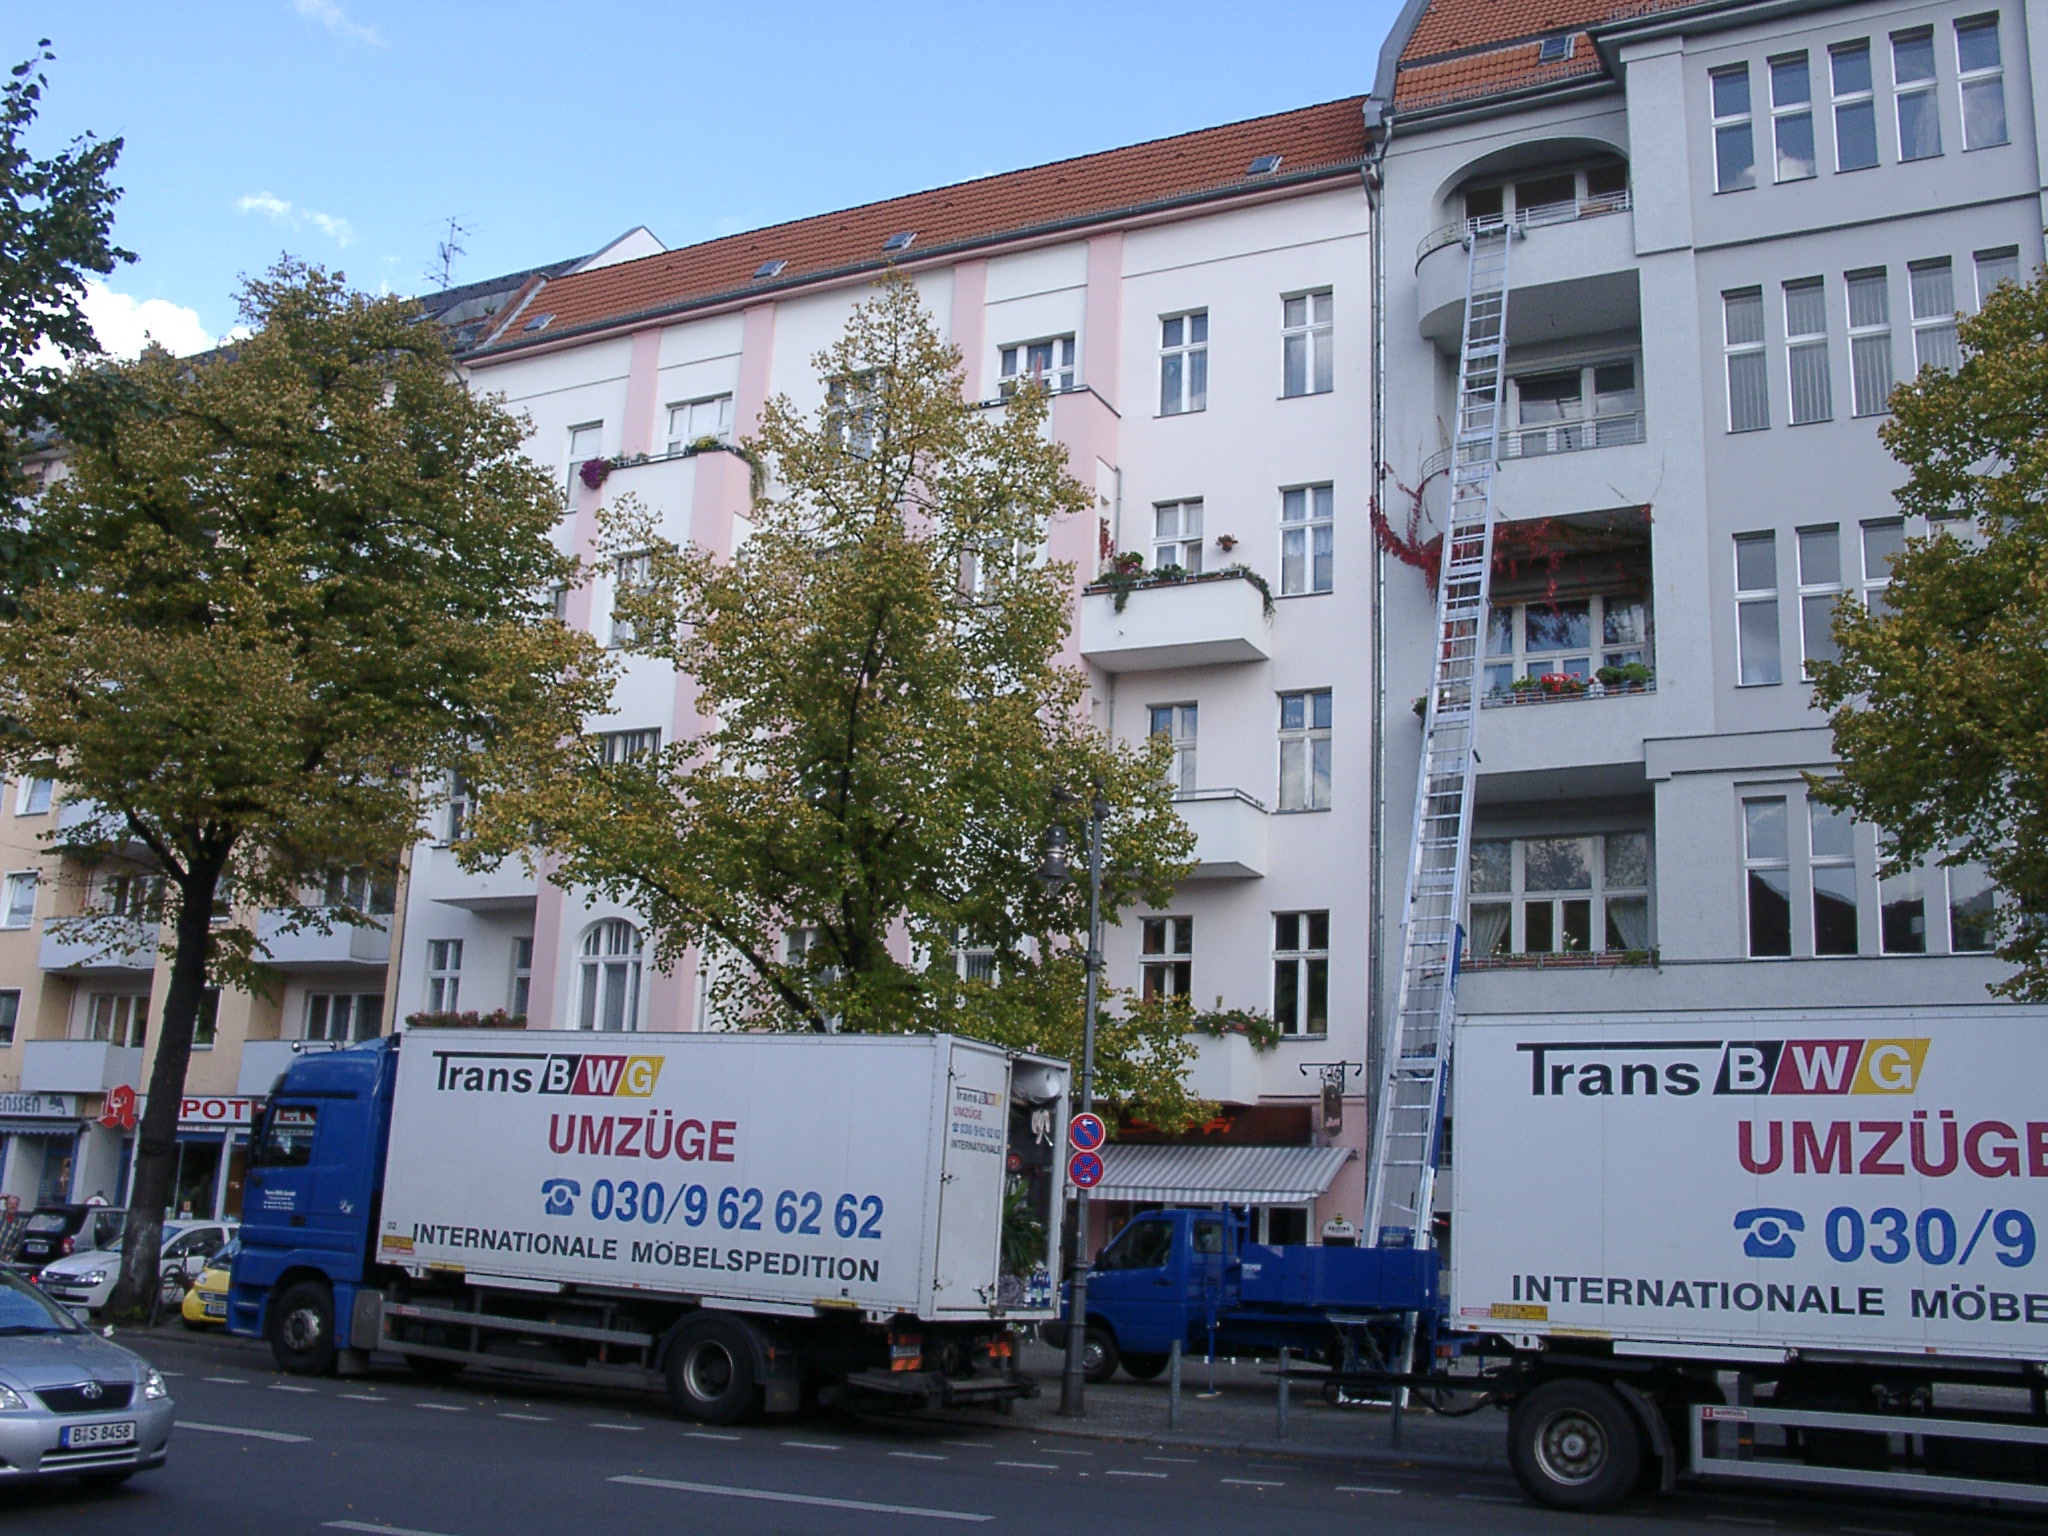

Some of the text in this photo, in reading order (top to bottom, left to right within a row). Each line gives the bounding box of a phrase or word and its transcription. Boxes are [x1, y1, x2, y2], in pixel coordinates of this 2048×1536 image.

[432, 1050, 658, 1096] Trans BWG
[1516, 1041, 1922, 1096] Trans BWG
[548, 1109, 737, 1162] UMZÜGE
[591, 1179, 884, 1240] 030/9 62 62 62
[413, 1223, 618, 1261] INTERNATIONALE
[1825, 1206, 2037, 1268] 030/9
[631, 1239, 880, 1283] MÖBELSPEDITION
[1512, 1275, 1885, 1317] INTERNATIONALE
[100, 1424, 131, 1440] 8458
